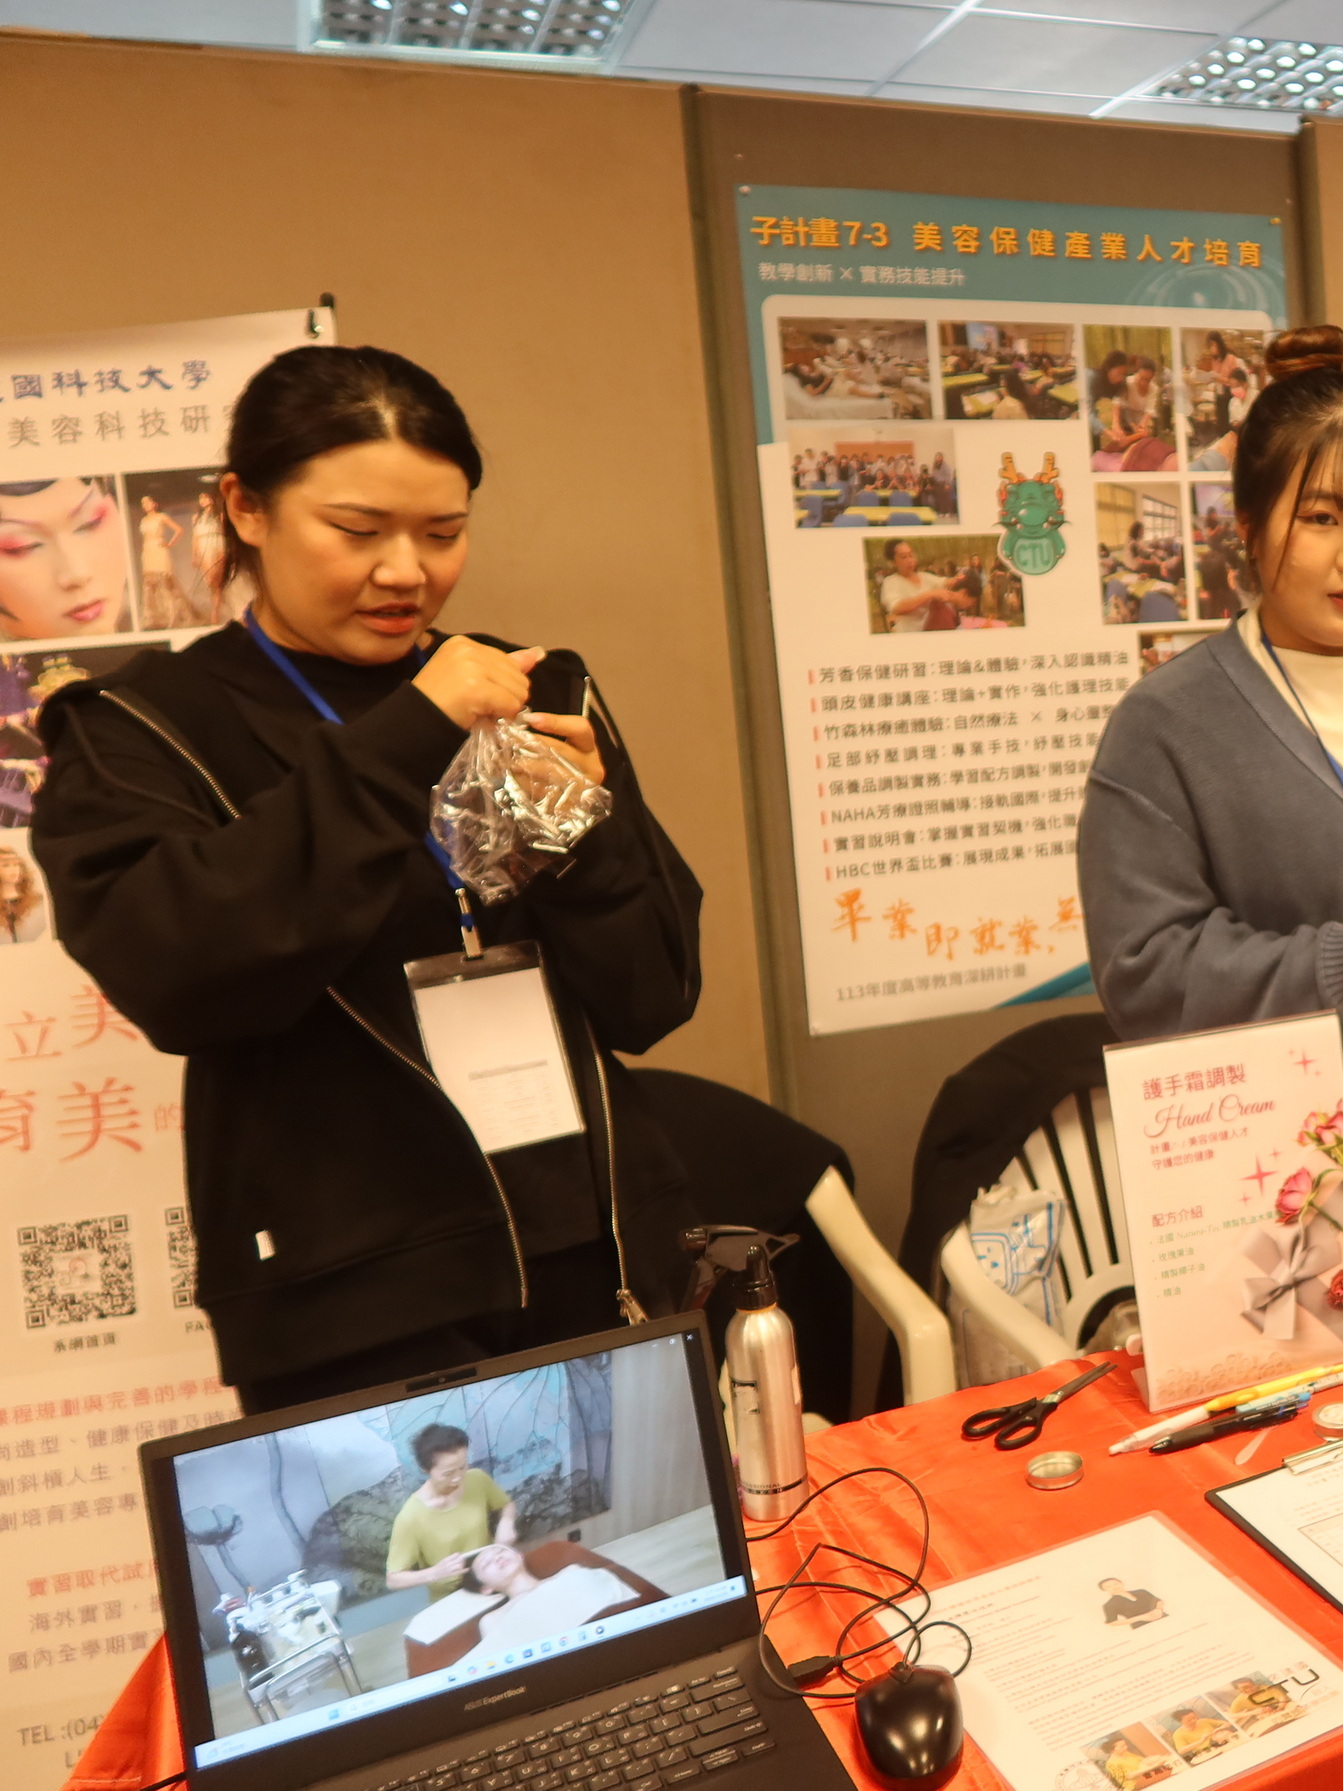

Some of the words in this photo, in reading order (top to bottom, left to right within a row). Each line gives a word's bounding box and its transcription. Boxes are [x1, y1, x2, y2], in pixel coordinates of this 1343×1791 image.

[750, 215, 889, 248] 子計畫7-3
[913, 221, 1262, 268] 美容保健產業人才培育
[759, 262, 832, 282] 教學創新
[860, 265, 965, 286] 實務技能提升
[0, 360, 210, 399] 國科技大學
[1017, 542, 1052, 569] CTU
[1143, 1063, 1246, 1100] 護手霜調製
[1144, 1102, 1214, 1138] Hand
[1219, 1094, 1275, 1122] Cream
[1152, 1205, 1203, 1227] 配方介紹
[27, 1559, 156, 1598] 實習取代試
[482, 1686, 527, 1706] ExpertBook
